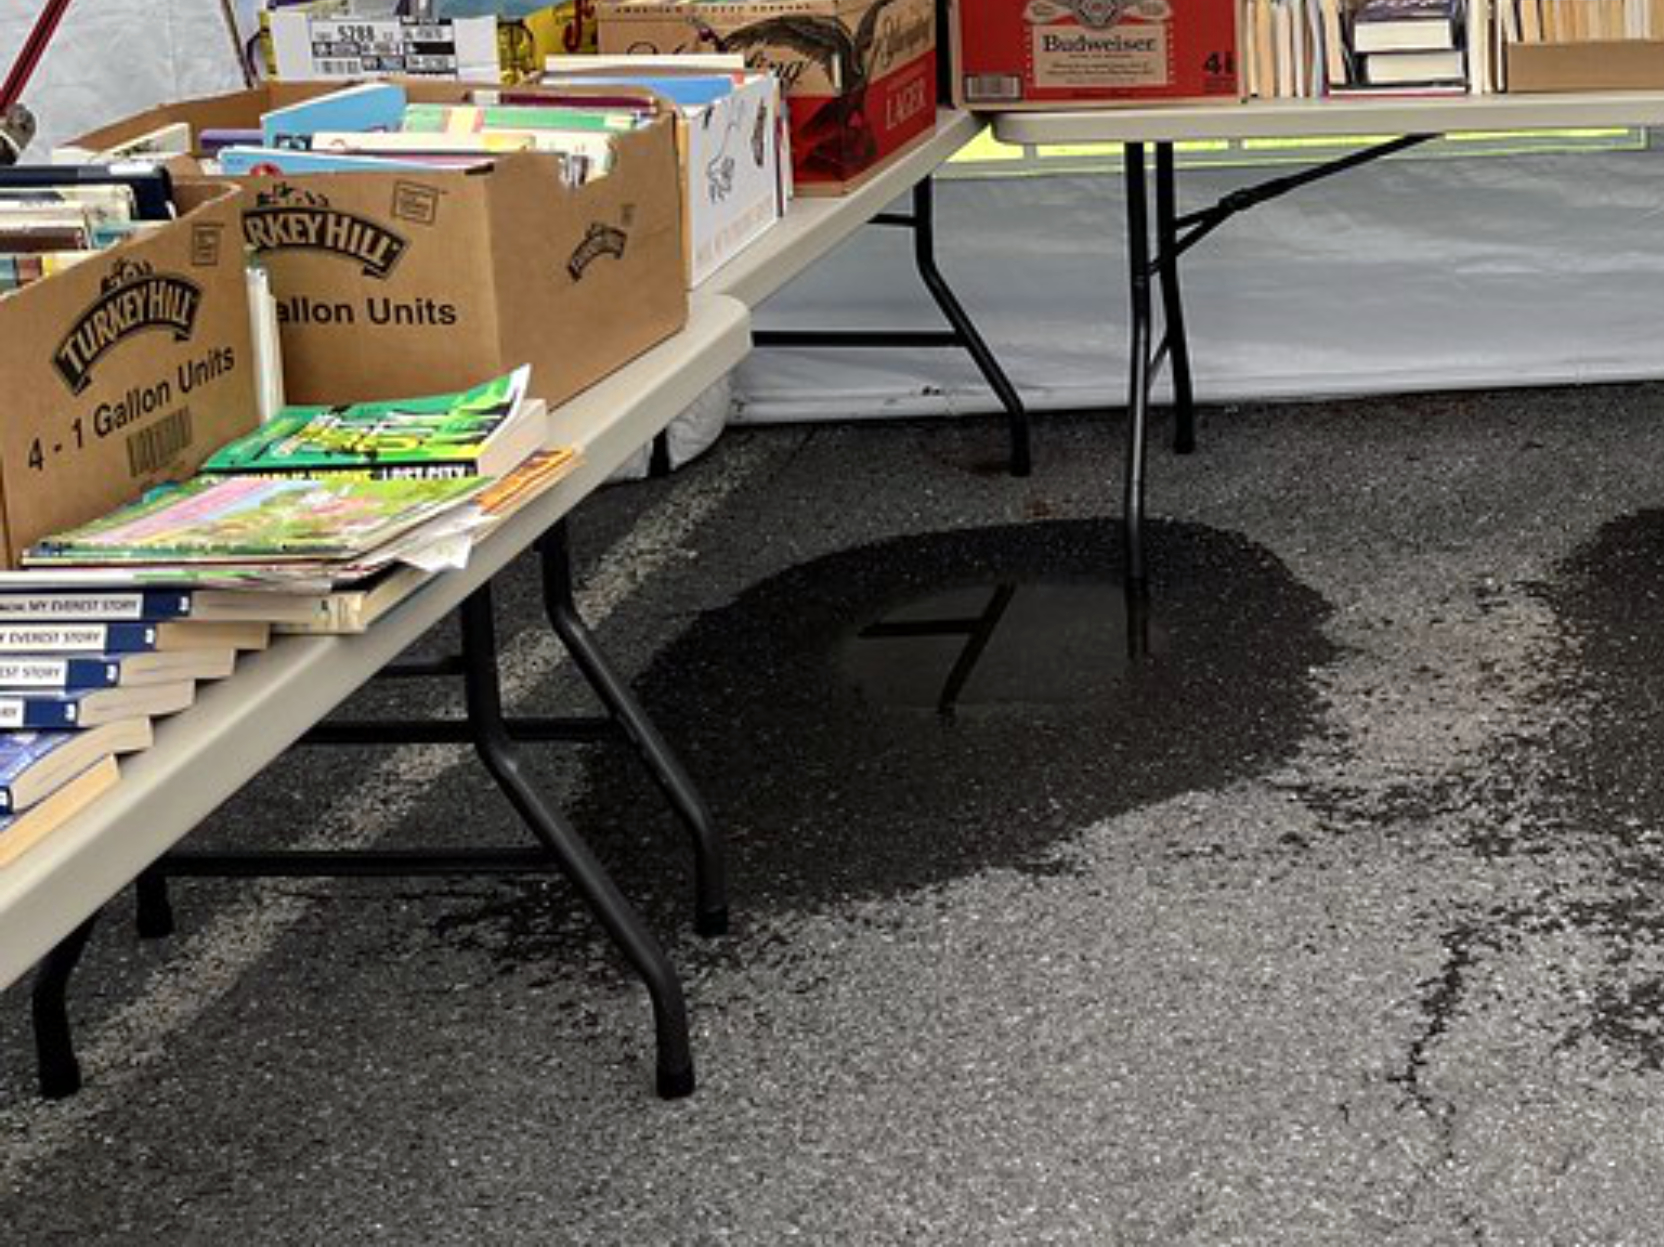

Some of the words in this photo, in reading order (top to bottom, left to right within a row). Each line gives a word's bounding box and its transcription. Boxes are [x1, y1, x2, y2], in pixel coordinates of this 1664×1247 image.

[1042, 34, 1156, 53] Budweiser
[244, 215, 320, 250] RKEY
[324, 214, 394, 268] HILL
[275, 297, 354, 325] allon
[367, 298, 457, 325] Units
[61, 283, 148, 376] TURKEY
[149, 280, 197, 334] HILL
[29, 437, 44, 472] 4
[72, 419, 84, 449] 1
[93, 381, 171, 439] Gallon
[177, 346, 235, 394] Units
[28, 599, 47, 611] MY
[51, 599, 99, 611] EVEREST
[103, 599, 138, 611] STORY
[9, 632, 59, 643] EVEREST
[63, 632, 101, 643] STORY
[23, 666, 61, 678] STORY
